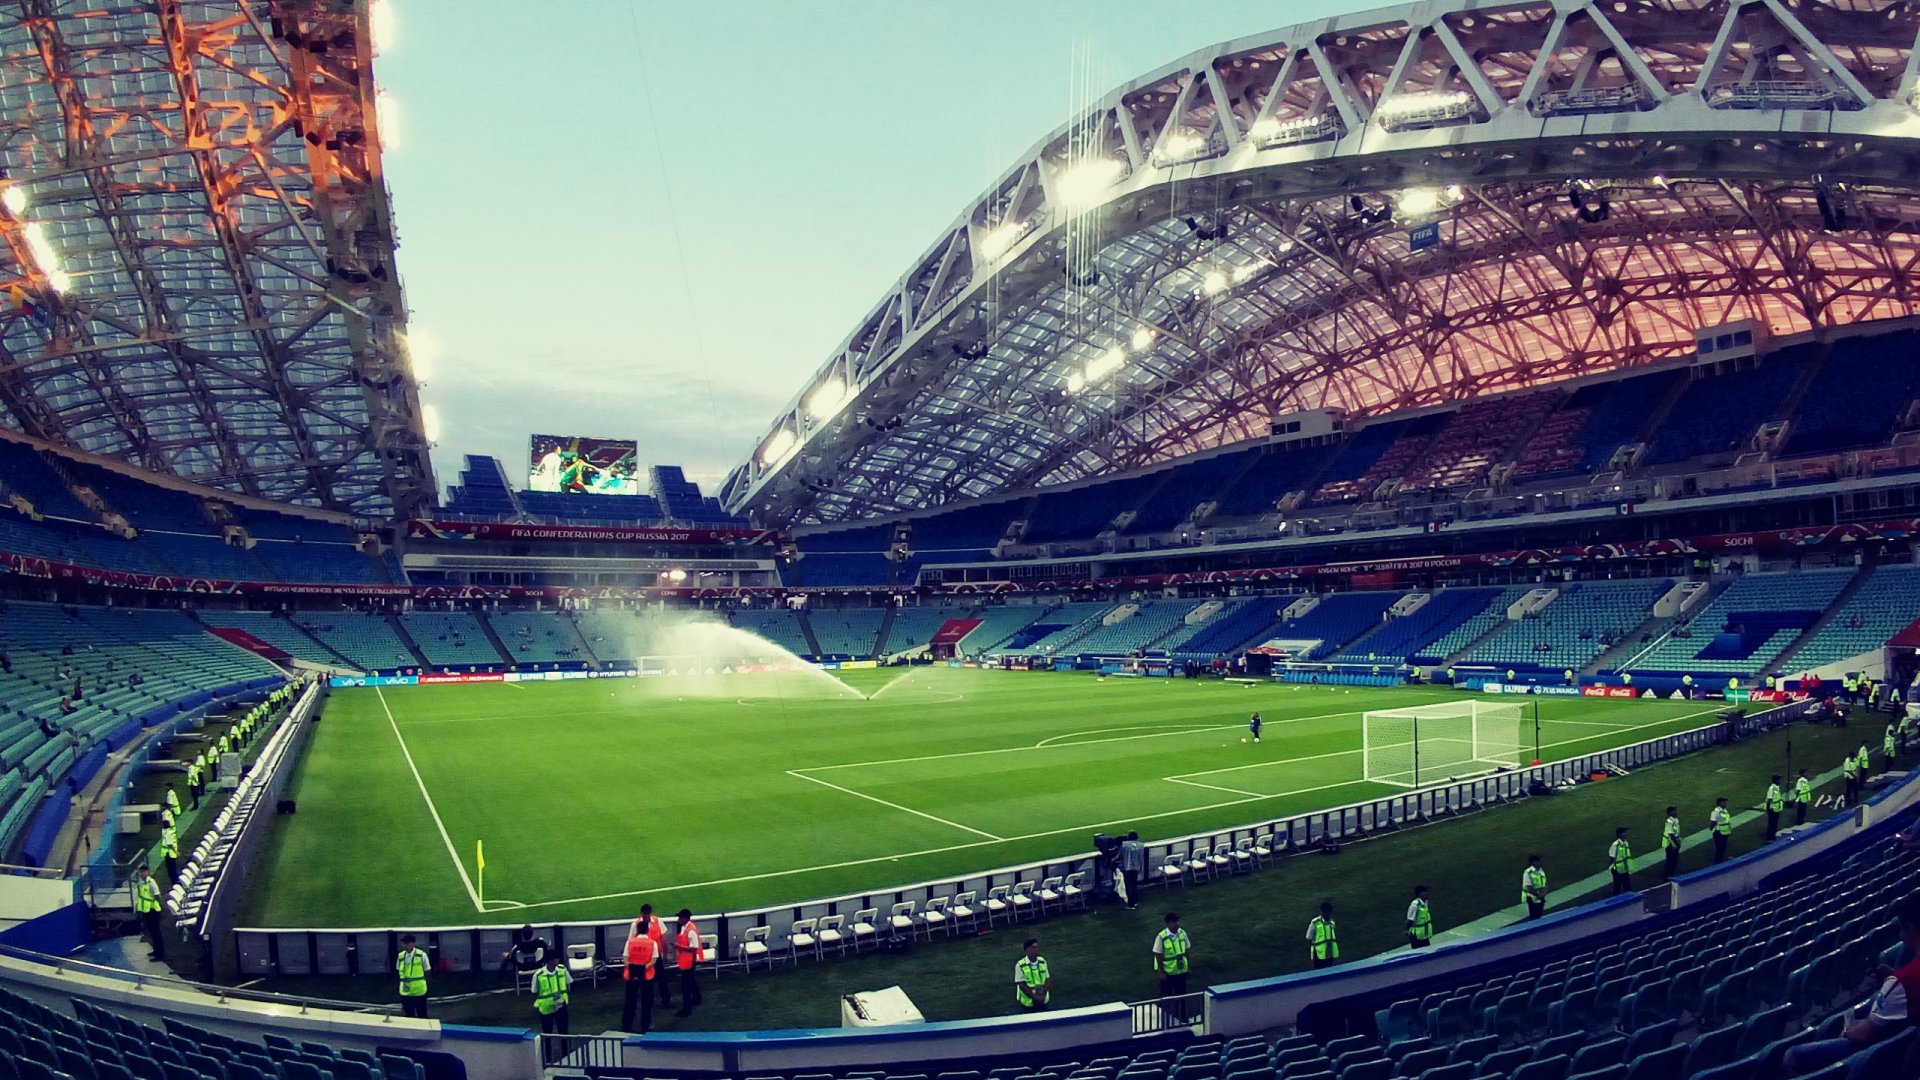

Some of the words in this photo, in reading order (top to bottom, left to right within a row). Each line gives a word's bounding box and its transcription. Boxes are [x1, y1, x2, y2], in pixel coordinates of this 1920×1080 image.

[1412, 227, 1432, 242] FIFA
[511, 529, 532, 537] FIFA
[533, 530, 614, 539] CONFEDERATIONS
[616, 531, 634, 540] CUP
[635, 532, 669, 540] RUSSIA
[1724, 537, 1753, 546] SOCHI
[1751, 690, 1775, 701] Bud
